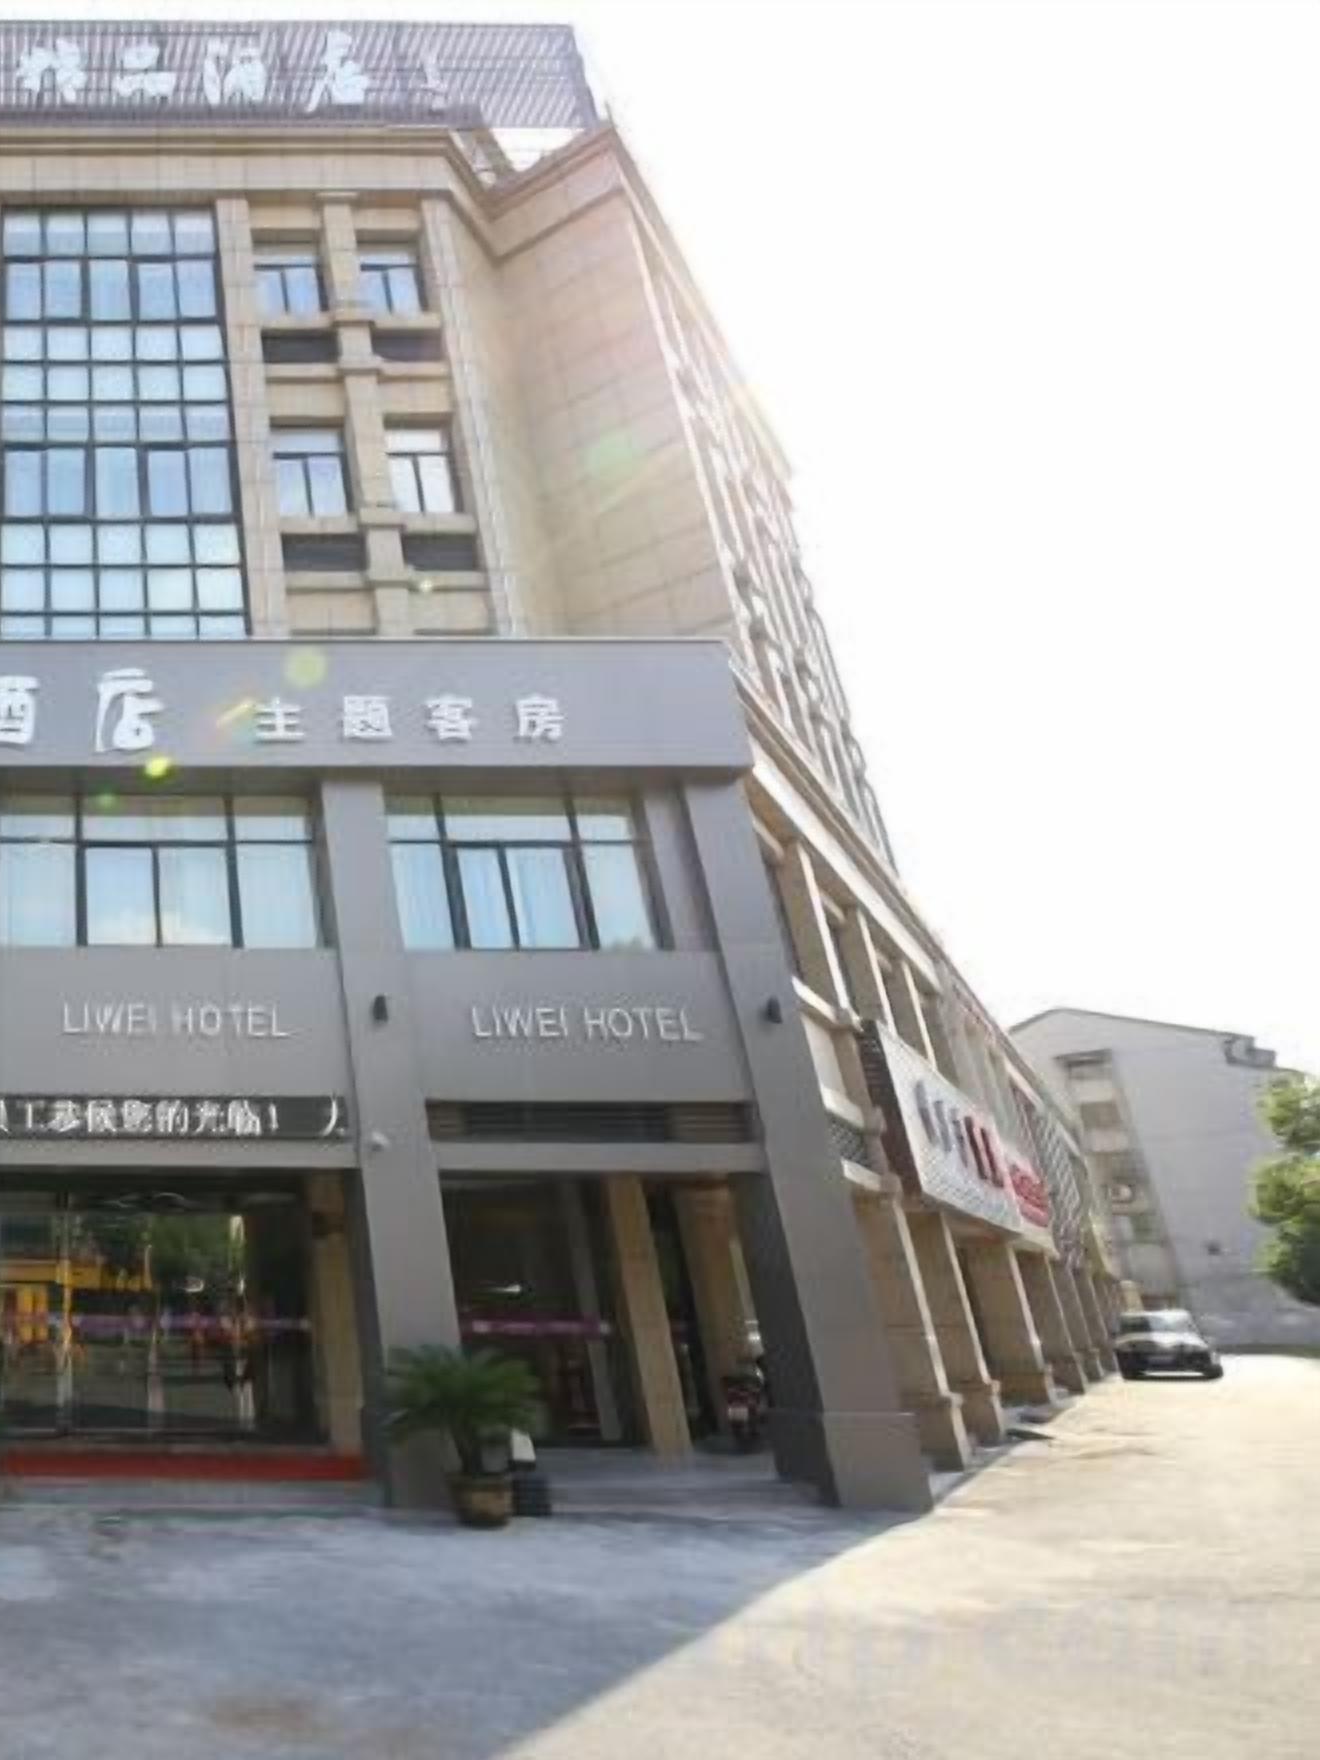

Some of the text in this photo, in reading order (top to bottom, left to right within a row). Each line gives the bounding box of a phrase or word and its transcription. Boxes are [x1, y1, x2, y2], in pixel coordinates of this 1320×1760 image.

[254, 695, 564, 743] 主题客房
[63, 1003, 290, 1037] LIWEI HOTEL
[472, 1006, 704, 1041] LIWEI HOTEL
